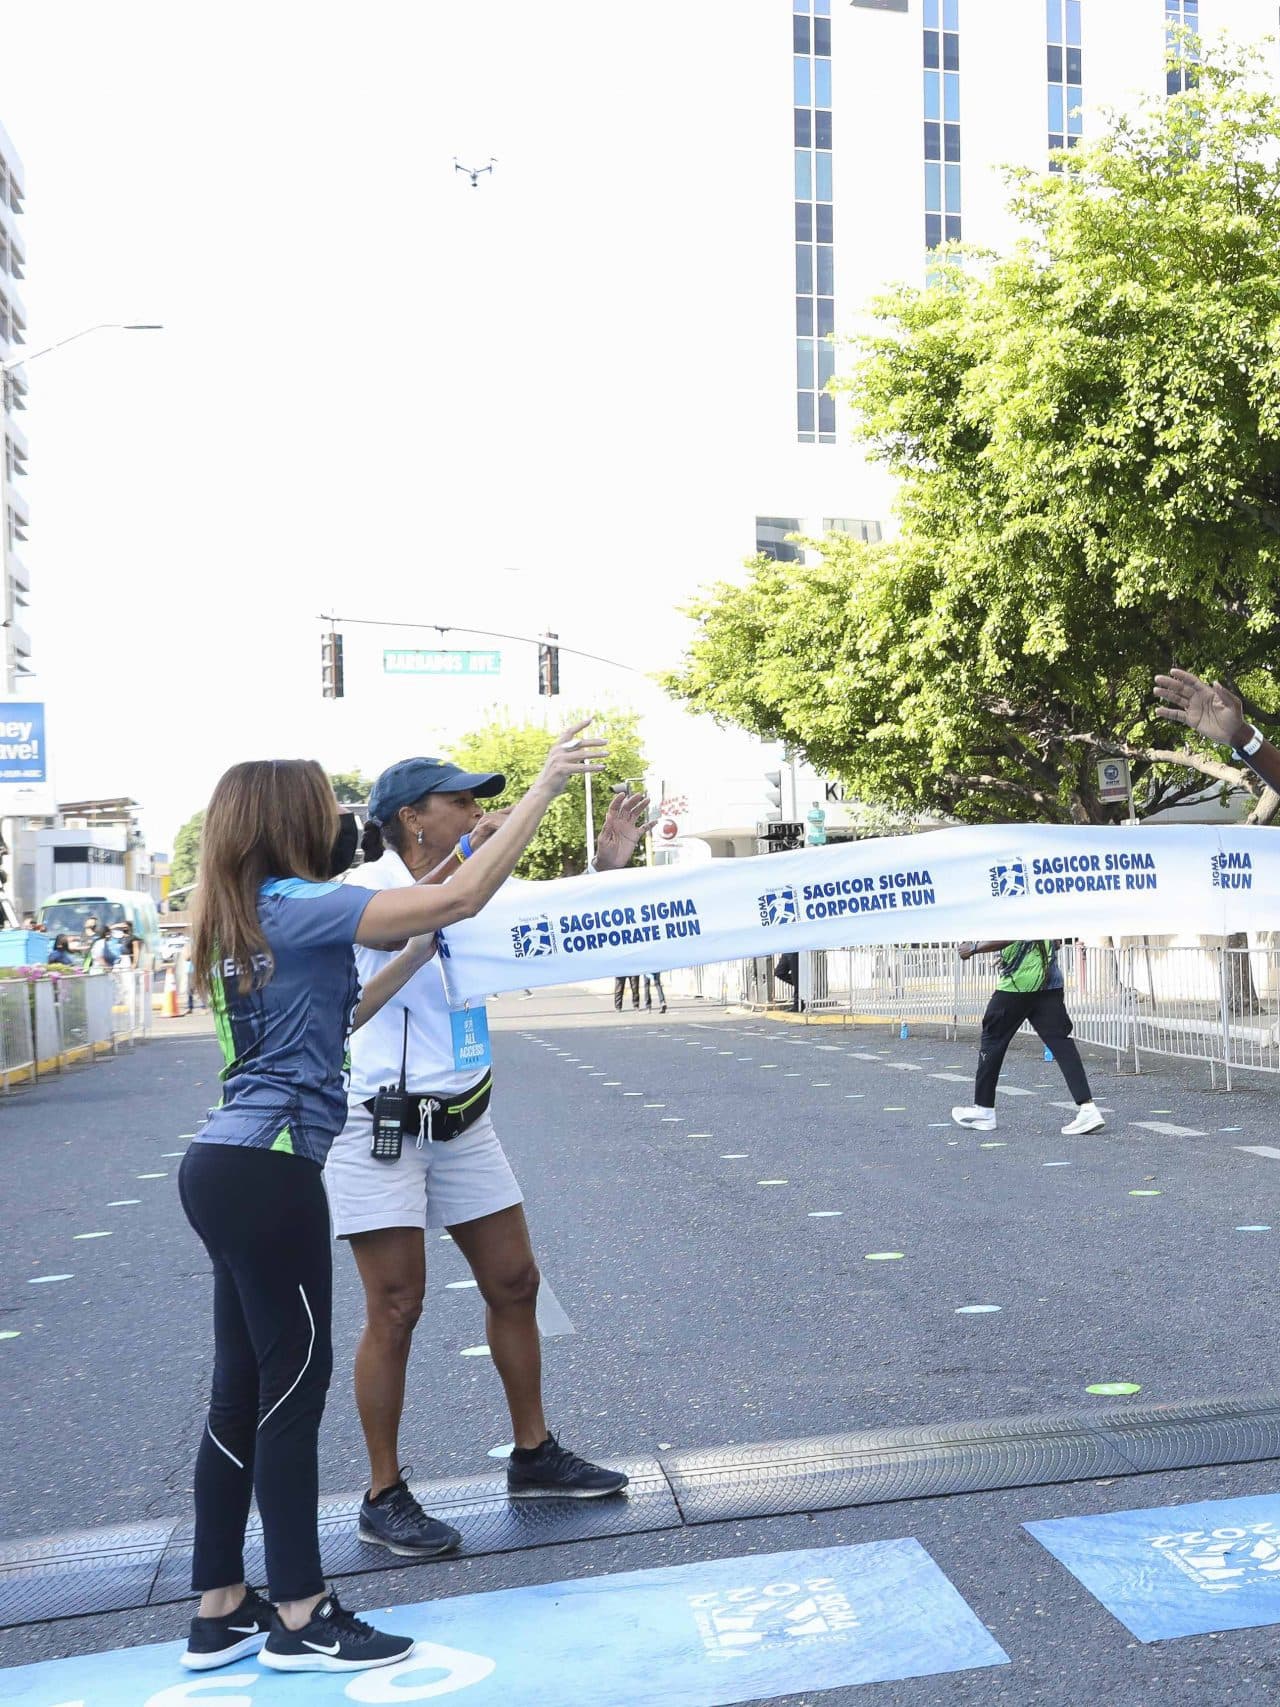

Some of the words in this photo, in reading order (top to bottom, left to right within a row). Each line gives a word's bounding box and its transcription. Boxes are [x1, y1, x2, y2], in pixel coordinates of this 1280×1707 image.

[386, 653, 463, 671] BARBADOS
[1032, 854, 1100, 875] SAGICOR
[1105, 852, 1156, 871] SIGMA
[803, 877, 874, 900] SAGICOR
[879, 870, 933, 890] SIGMA
[989, 866, 1000, 897] SIGMA
[1035, 874, 1121, 894] CORPORATE
[1125, 873, 1157, 890] RUN
[1220, 873, 1251, 889] RUN
[559, 907, 637, 934] SAGICOR
[641, 899, 697, 923] SIGMA
[758, 895, 770, 927] SIGMA
[805, 892, 897, 920] CORPORATE
[902, 889, 936, 907] RUN
[511, 926, 524, 958] SIGMA
[563, 924, 661, 953] CORPORATE
[665, 919, 701, 939] RUN
[459, 1044, 485, 1058] ACCESS
[464, 1032, 477, 1045] ALL
[1145, 1522, 1280, 1549] 2022
